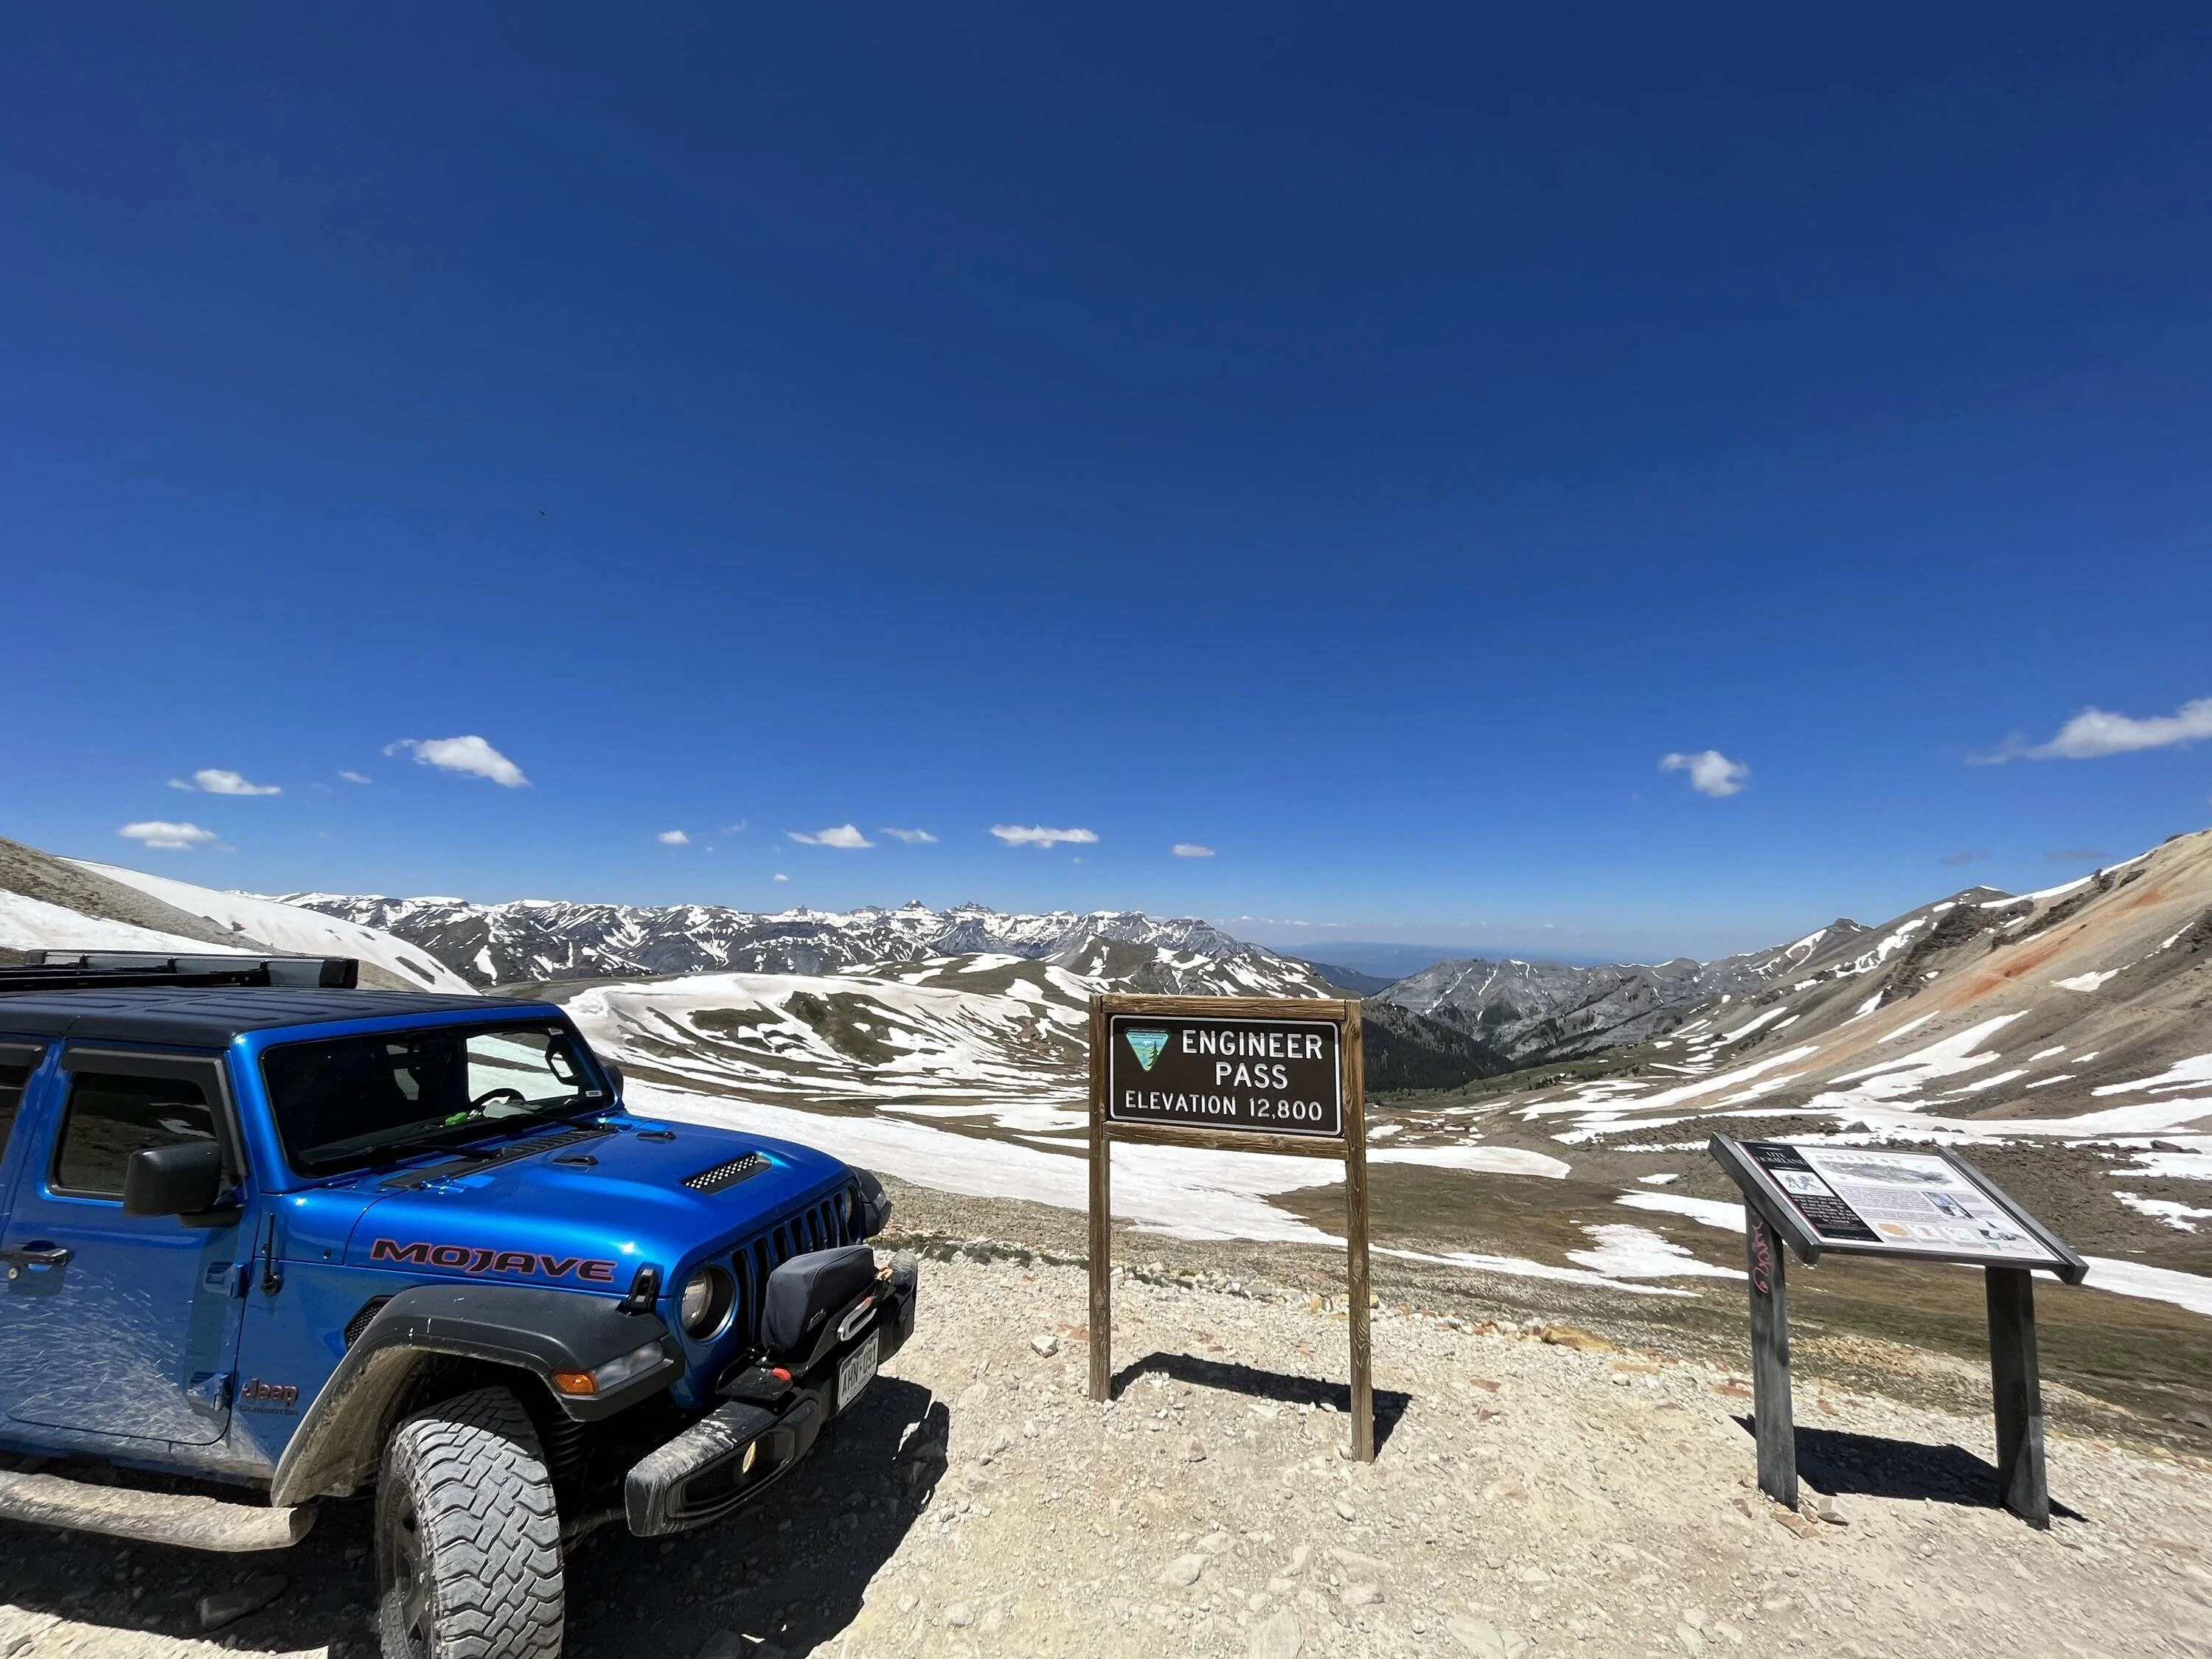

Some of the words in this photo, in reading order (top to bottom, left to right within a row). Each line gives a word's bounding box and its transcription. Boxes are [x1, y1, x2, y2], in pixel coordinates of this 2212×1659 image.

[1182, 1029, 1323, 1060] ENGINEER
[1215, 1061, 1289, 1090] PASS
[1124, 1090, 1237, 1116] ELEVATION
[1249, 1097, 1323, 1121] 12,800
[370, 1239, 619, 1283] MOJAVE
[242, 1377, 299, 1407] Jeep
